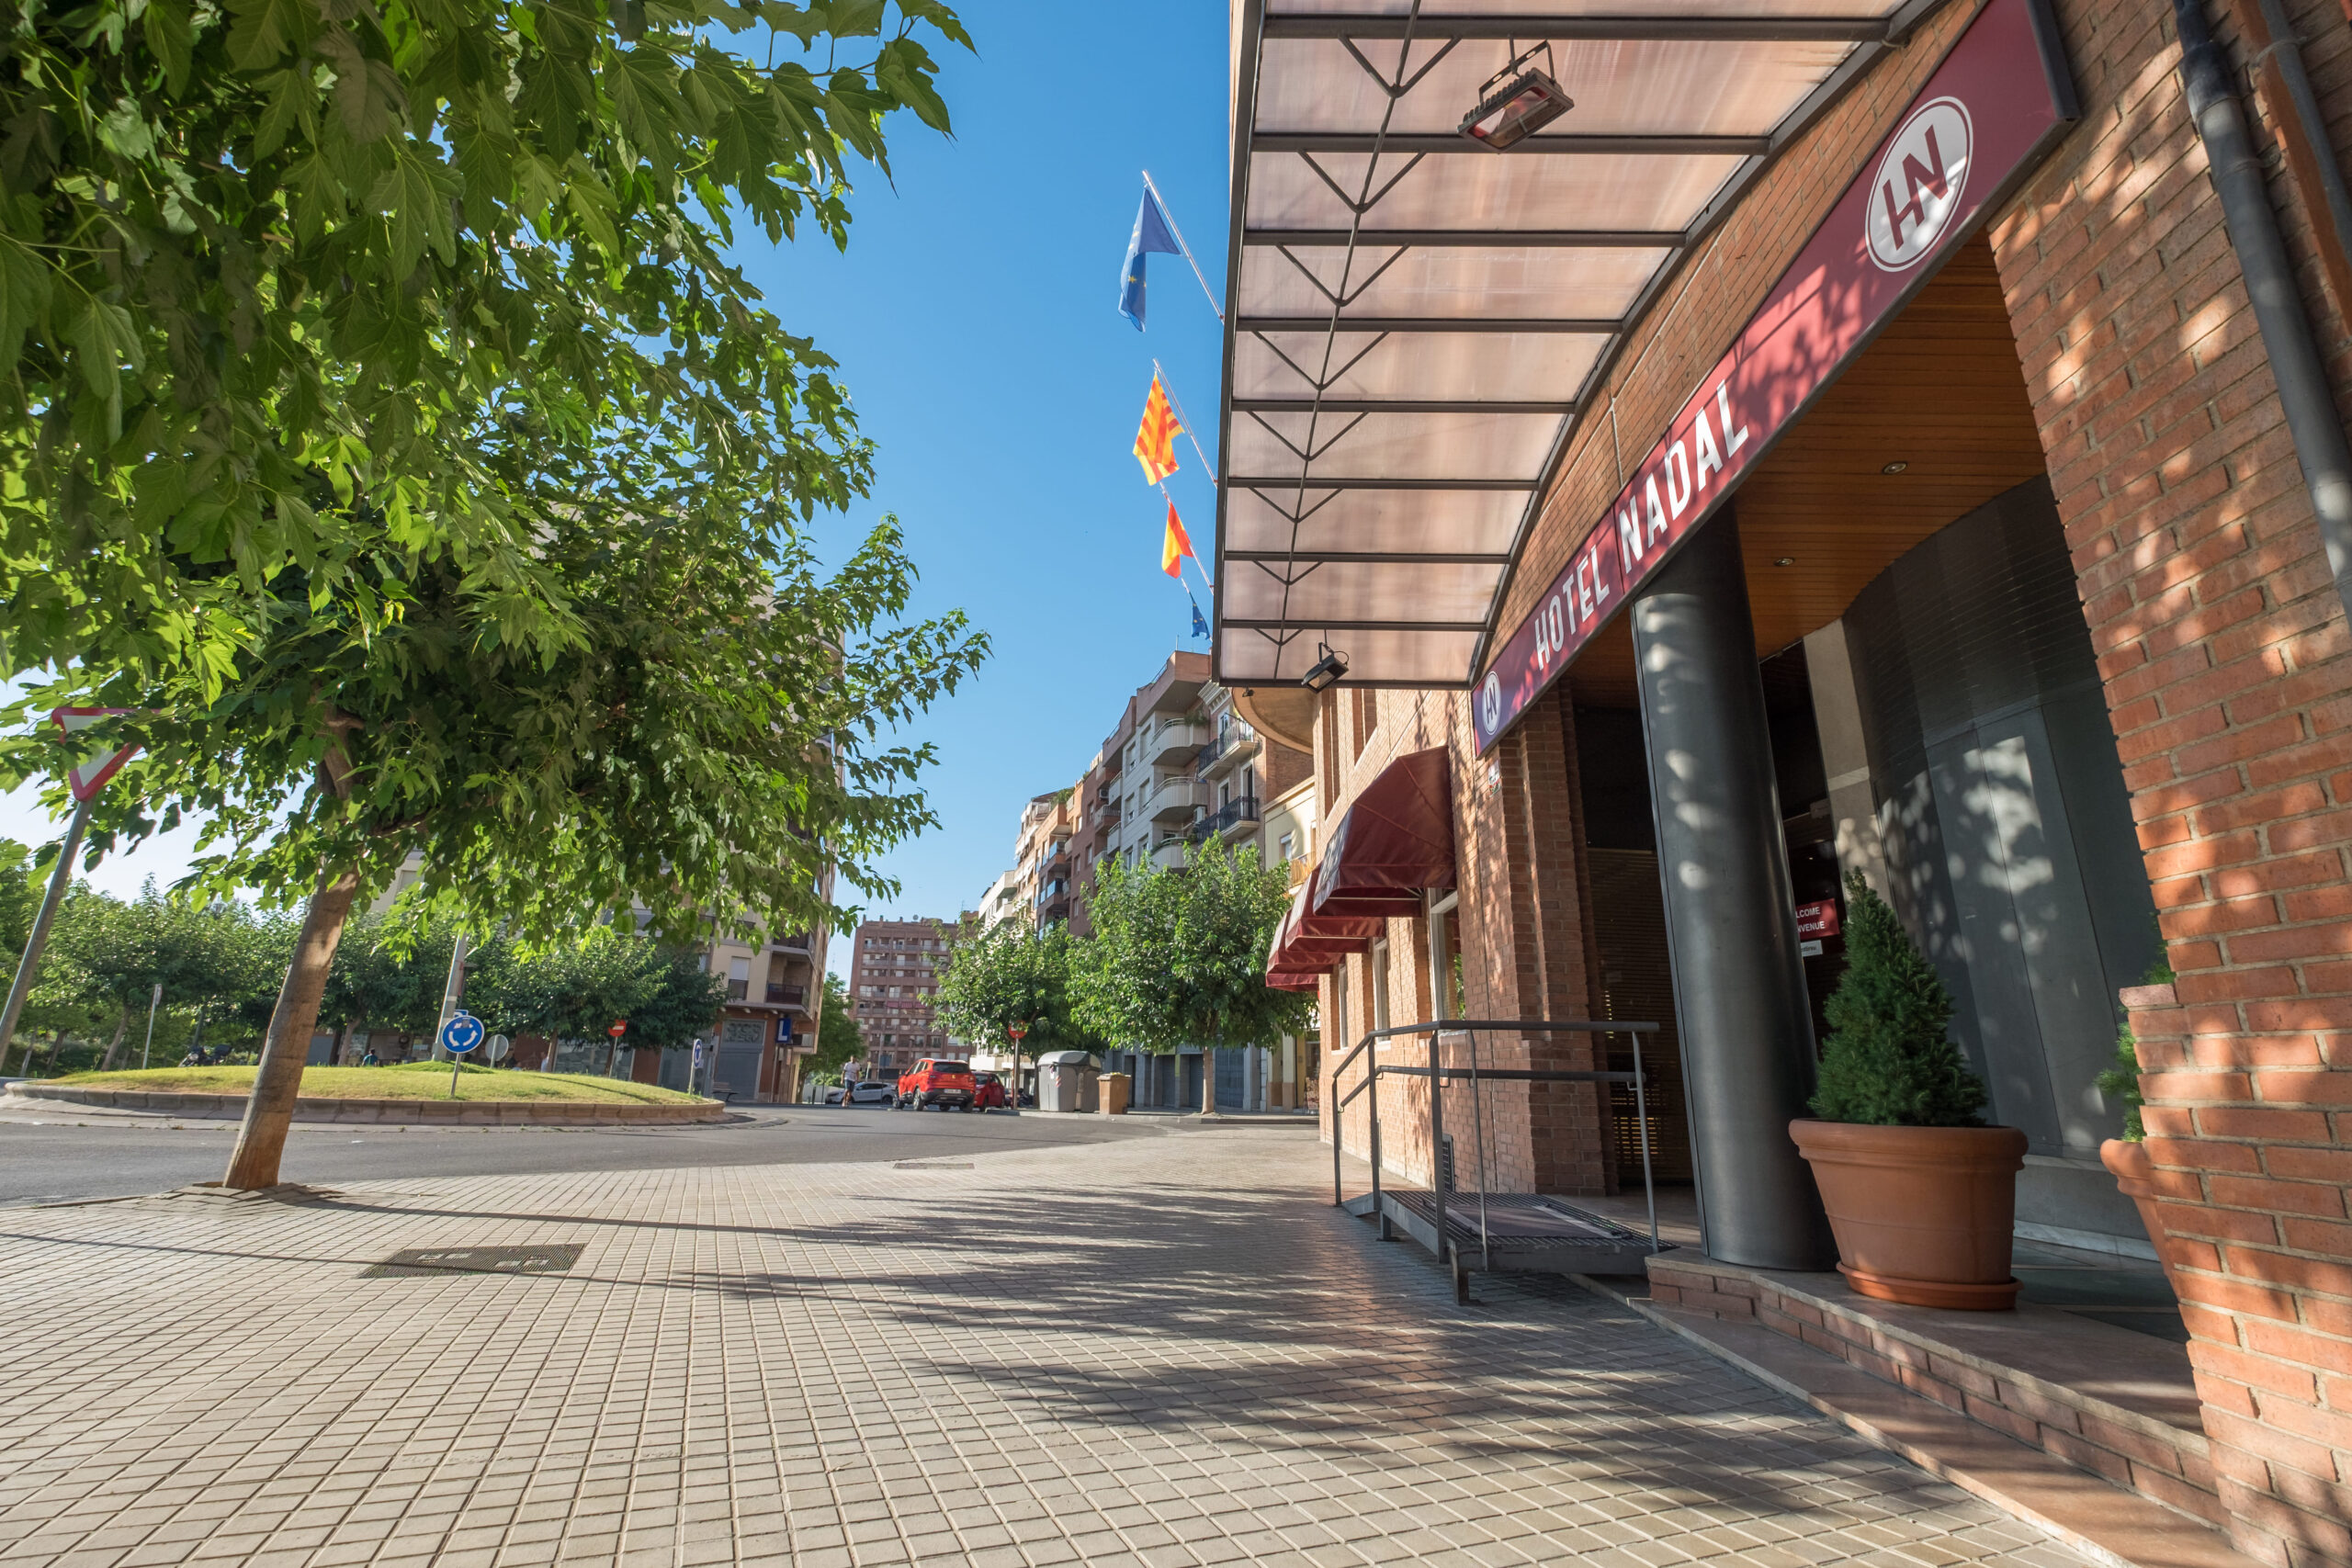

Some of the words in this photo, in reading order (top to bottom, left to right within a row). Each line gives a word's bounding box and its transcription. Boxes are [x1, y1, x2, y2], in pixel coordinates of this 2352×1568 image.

[1533, 544, 1610, 671] HOTEL
[1618, 379, 1749, 574] NADAL
[1795, 907, 1821, 919] LCOME
[1797, 920, 1826, 932] NVENUE
[777, 1020, 788, 1042] L
